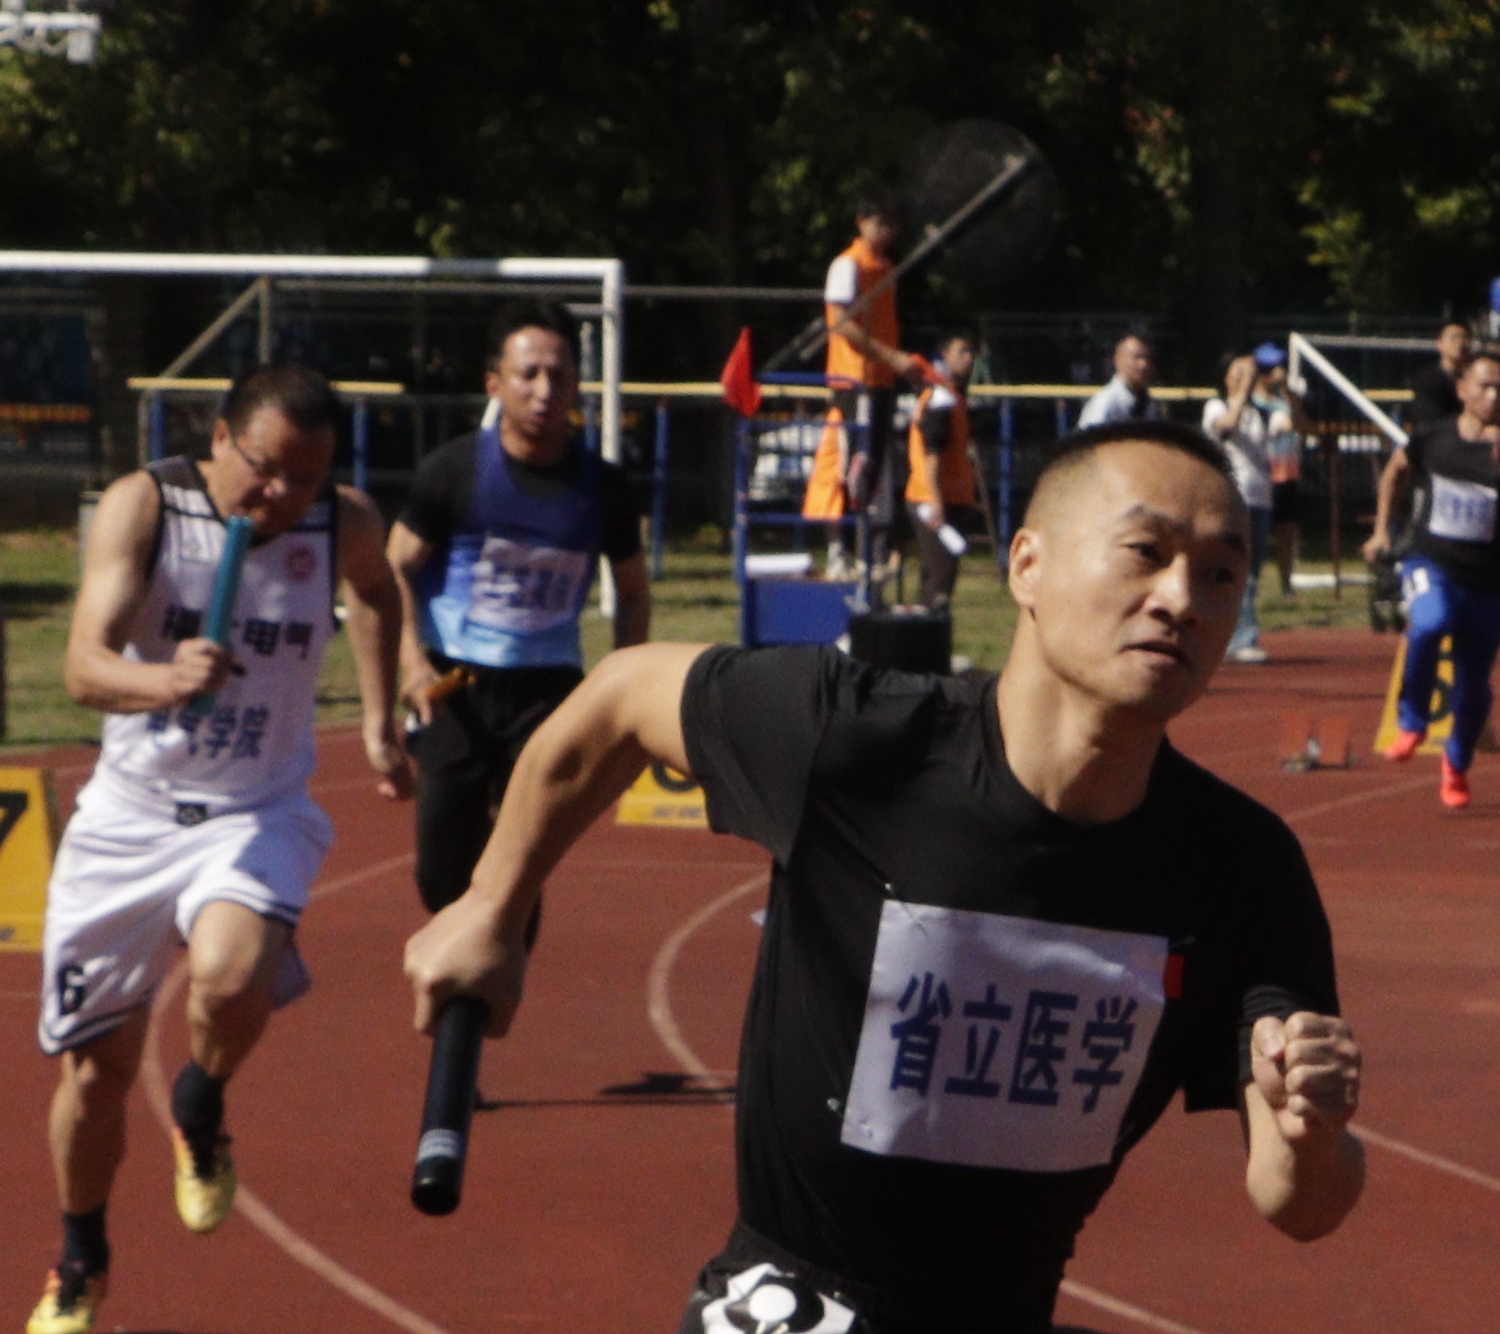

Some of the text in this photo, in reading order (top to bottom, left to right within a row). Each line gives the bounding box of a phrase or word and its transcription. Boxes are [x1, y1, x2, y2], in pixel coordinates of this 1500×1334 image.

[163, 604, 314, 659] 福电气
[57, 963, 85, 1015] 6
[890, 970, 1138, 1114] 省立医学
